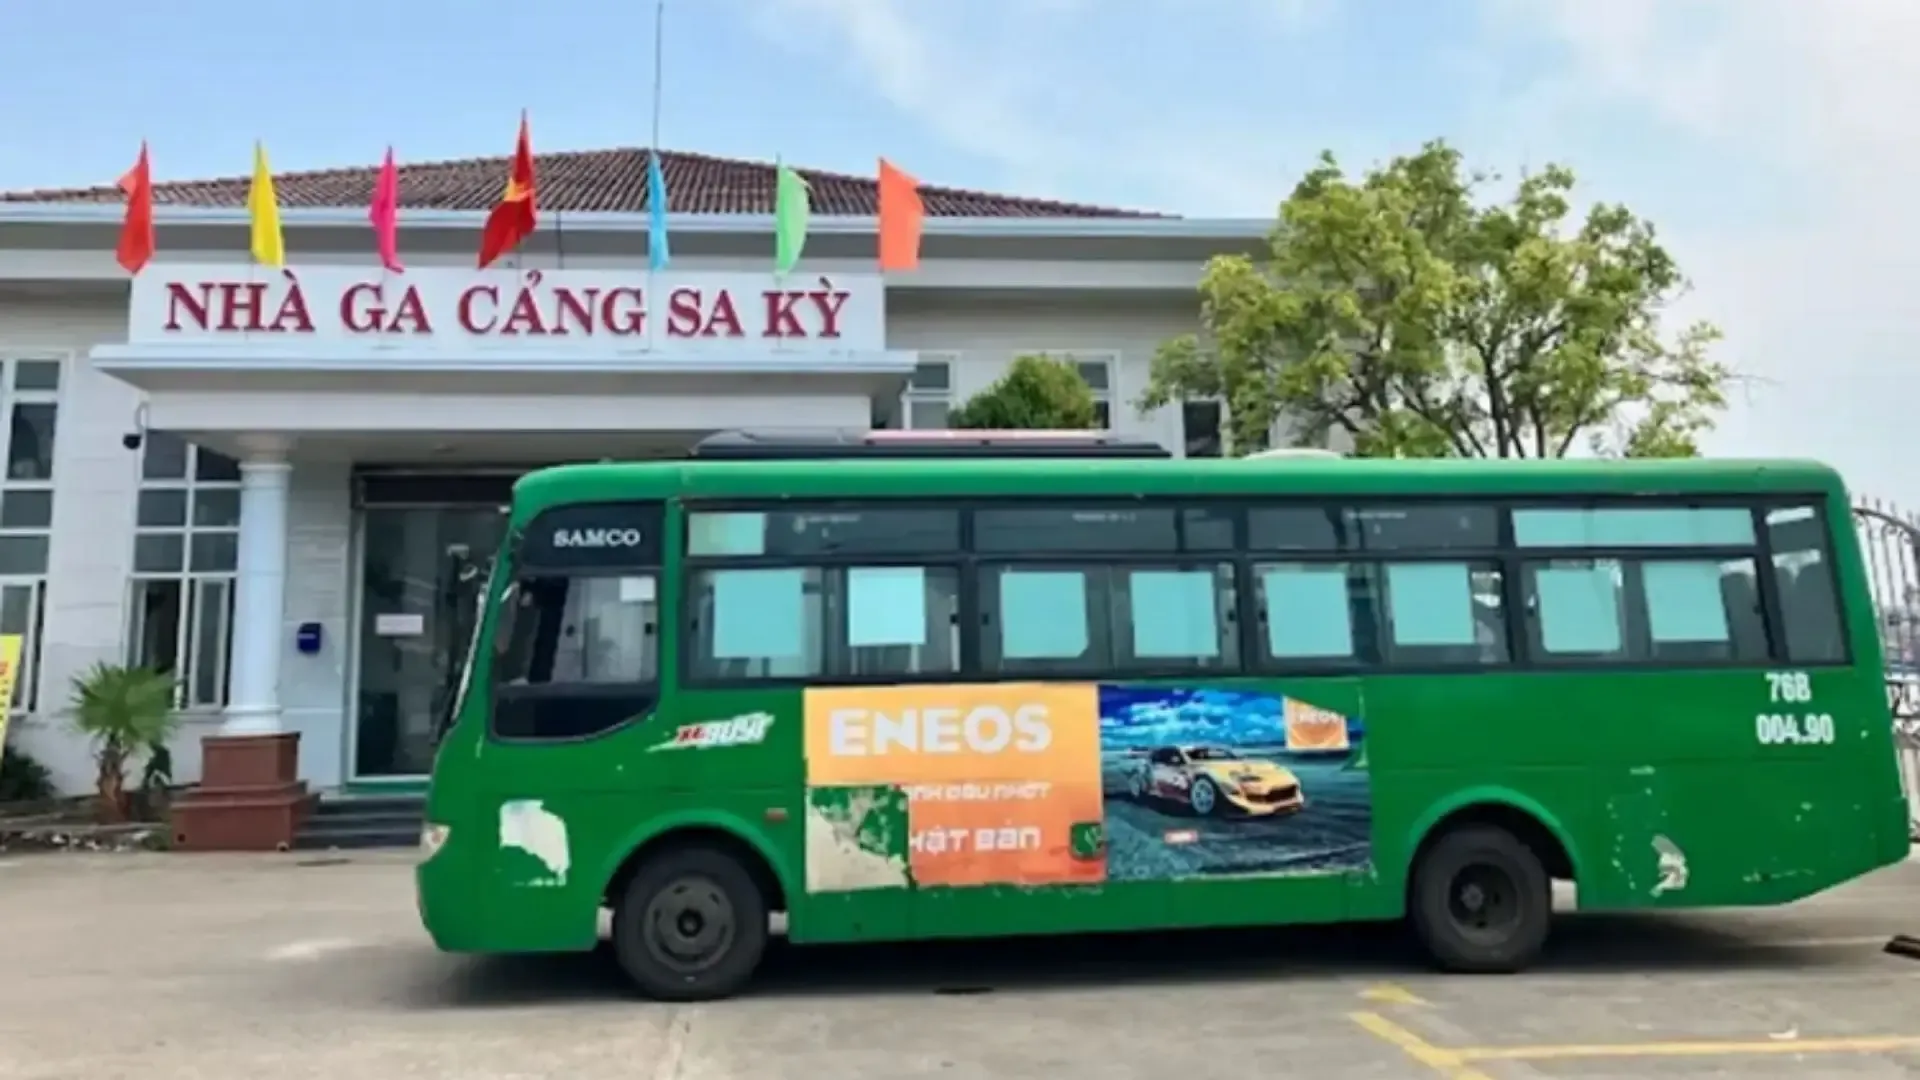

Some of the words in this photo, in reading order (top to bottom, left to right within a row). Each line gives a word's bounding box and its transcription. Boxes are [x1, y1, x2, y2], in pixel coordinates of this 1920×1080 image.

[164, 268, 315, 333] NHÀ
[340, 282, 433, 334] GA
[457, 270, 647, 335] CẢNG
[667, 288, 745, 337] SA
[761, 276, 851, 338] KỲ
[553, 528, 641, 547] SAMCO
[1765, 672, 1812, 702] 76B
[829, 703, 1053, 756] ENEOS
[909, 824, 969, 856] HẬT
